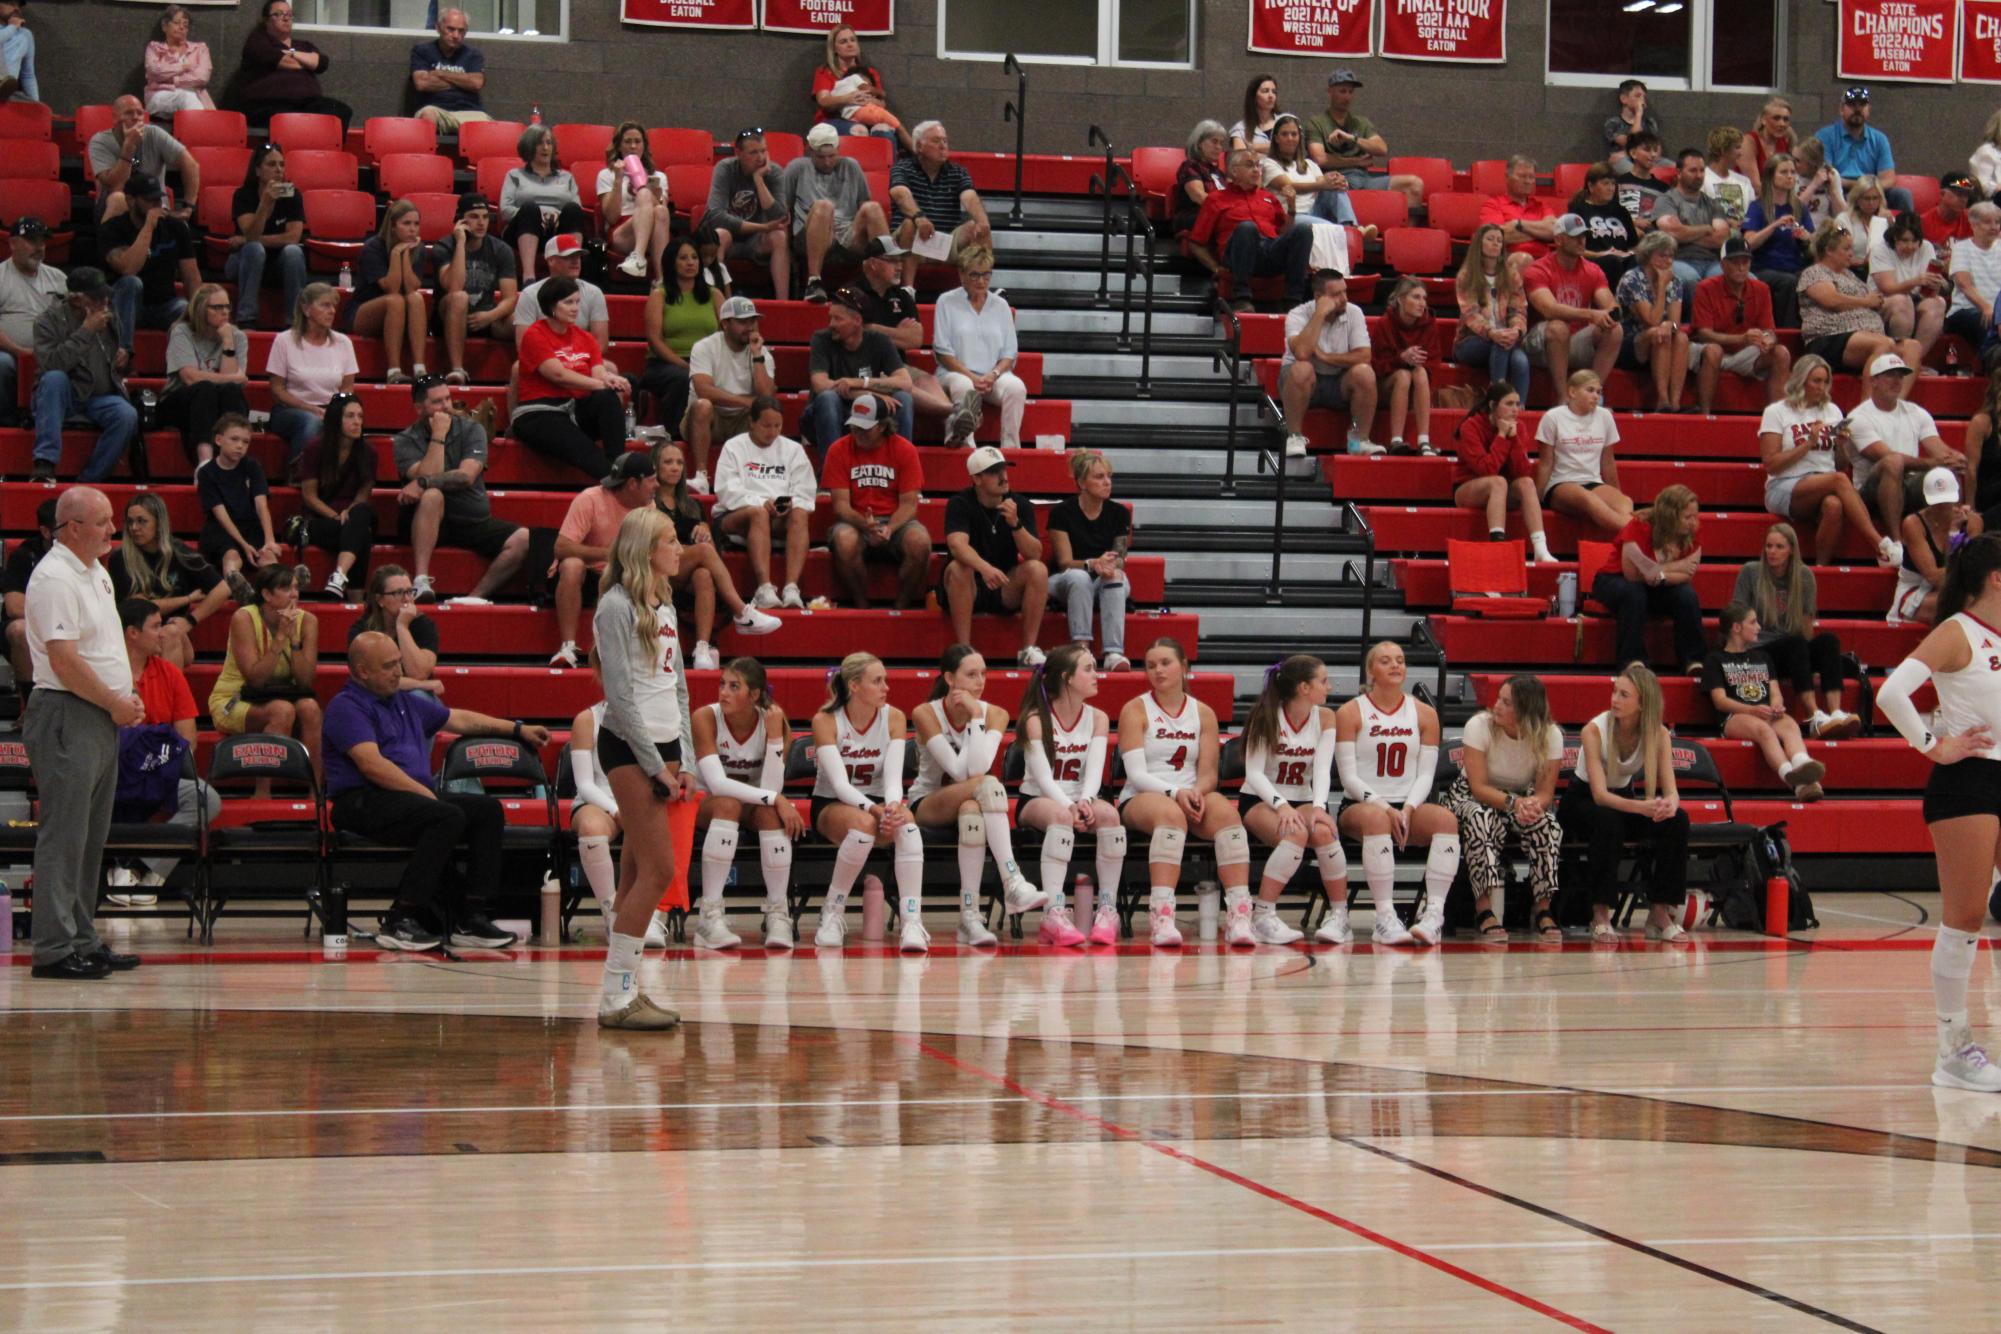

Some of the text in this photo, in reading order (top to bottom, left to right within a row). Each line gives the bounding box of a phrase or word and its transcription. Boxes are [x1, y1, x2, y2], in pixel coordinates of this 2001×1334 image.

[671, 5, 702, 17] EATON
[800, 0, 854, 12] FOOTBALL
[1397, 0, 1490, 19] FINAL FOUR
[1881, 3, 1916, 16] STATE
[811, 12, 841, 23] EATON
[1284, 7, 1338, 23] 2021 AAA
[1416, 12, 1469, 28] 2021 AAA
[1283, 21, 1339, 36] WRESTLING
[1854, 10, 1943, 39] CHAMPIONS
[1976, 14, 2001, 39] CH
[1295, 35, 1323, 46] EATON
[1418, 26, 1467, 40] SOFTBALL
[1427, 39, 1456, 51] EATON
[1873, 49, 1921, 61] BASEBALL
[1883, 61, 1910, 72] EATON
[851, 464, 895, 480] EATON
[858, 477, 888, 488] REDS
[1156, 728, 1195, 740] Eaton
[1369, 725, 1413, 737] Eaton
[232, 743, 287, 760] EATON
[466, 744, 519, 761] EATON
[841, 746, 880, 758] Eaton
[1166, 745, 1187, 771] 4
[1377, 742, 1407, 777] 10
[845, 764, 875, 786] 15
[1053, 758, 1081, 781] 16
[1276, 761, 1306, 785] 18
